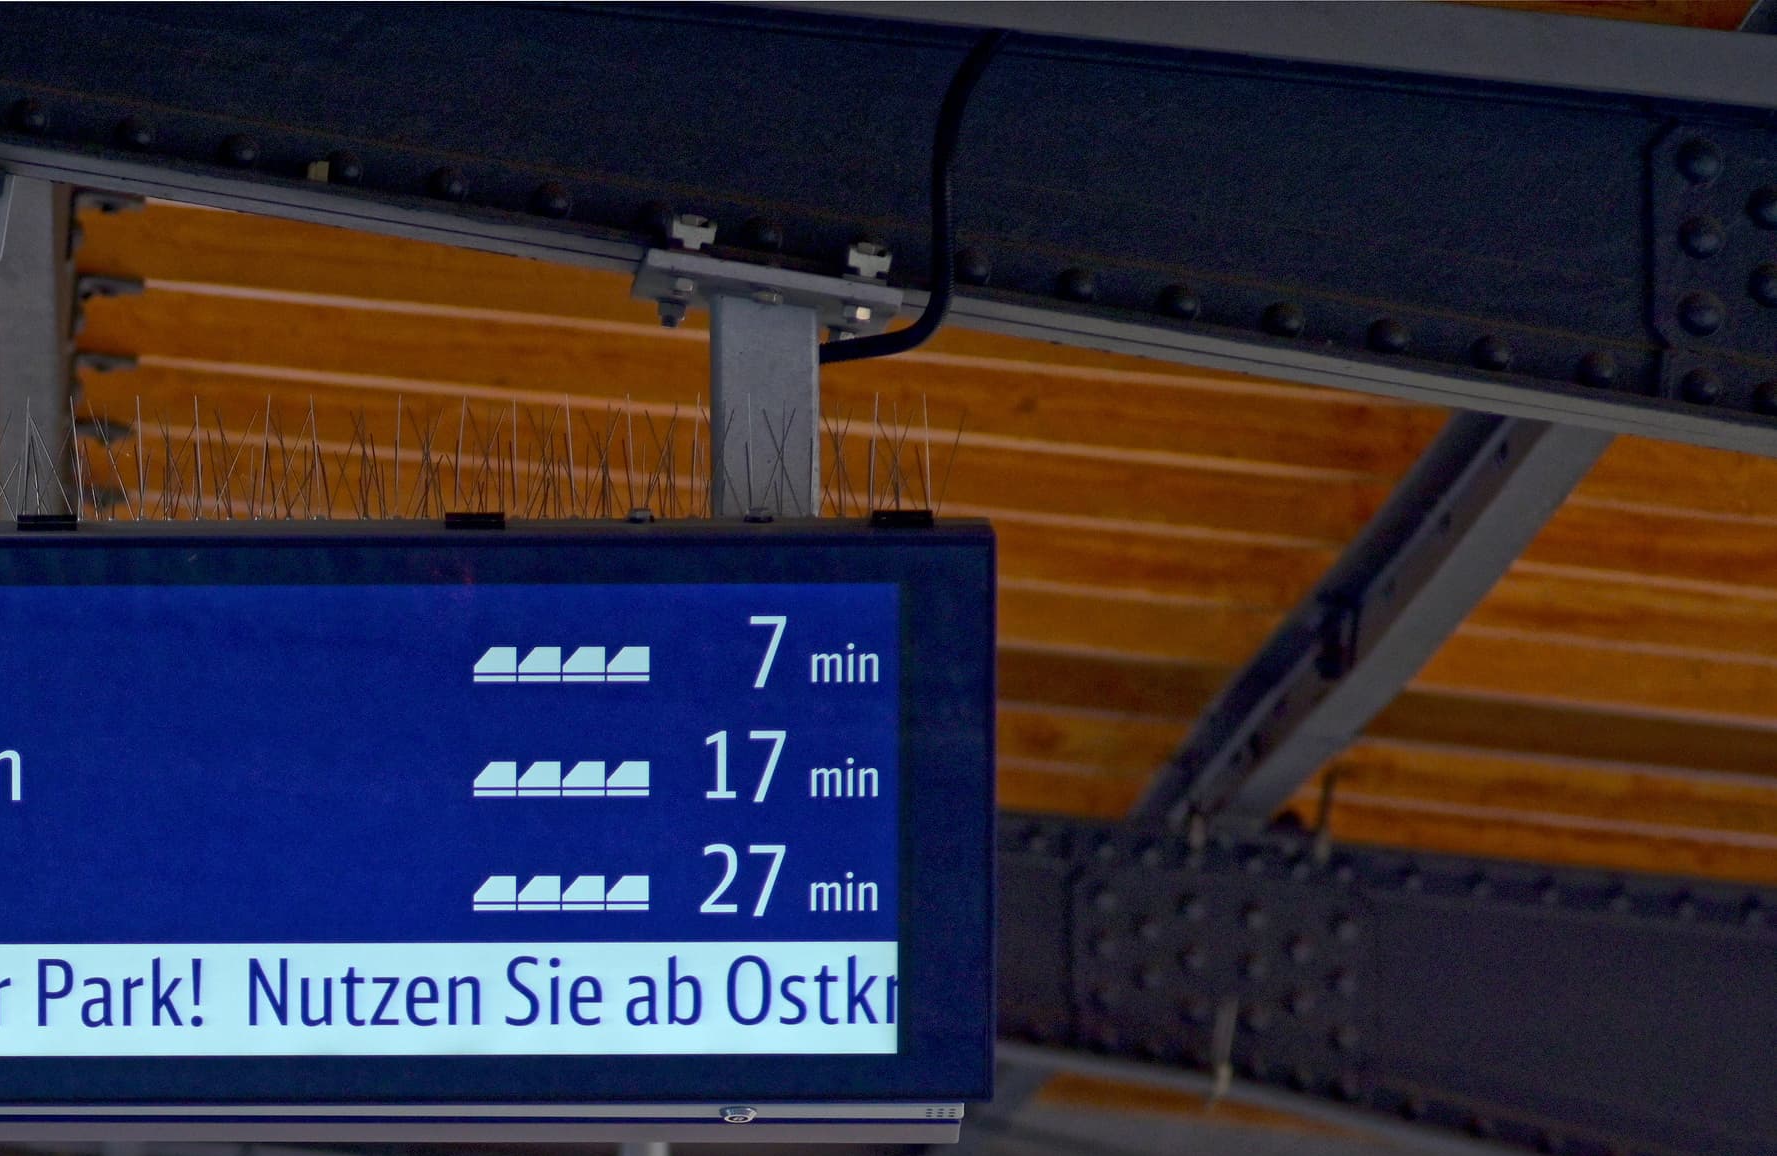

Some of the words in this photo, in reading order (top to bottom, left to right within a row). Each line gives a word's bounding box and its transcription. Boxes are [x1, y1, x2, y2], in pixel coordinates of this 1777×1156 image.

[749, 615, 787, 689] 7
[810, 642, 879, 684] min
[705, 730, 787, 803] 17
[810, 757, 879, 798] min
[699, 843, 786, 917] 27
[809, 871, 878, 912] min
[37, 957, 203, 1028] Park!
[248, 957, 481, 1027] Nutzen
[505, 955, 603, 1027] Sie
[625, 955, 702, 1027] ab
